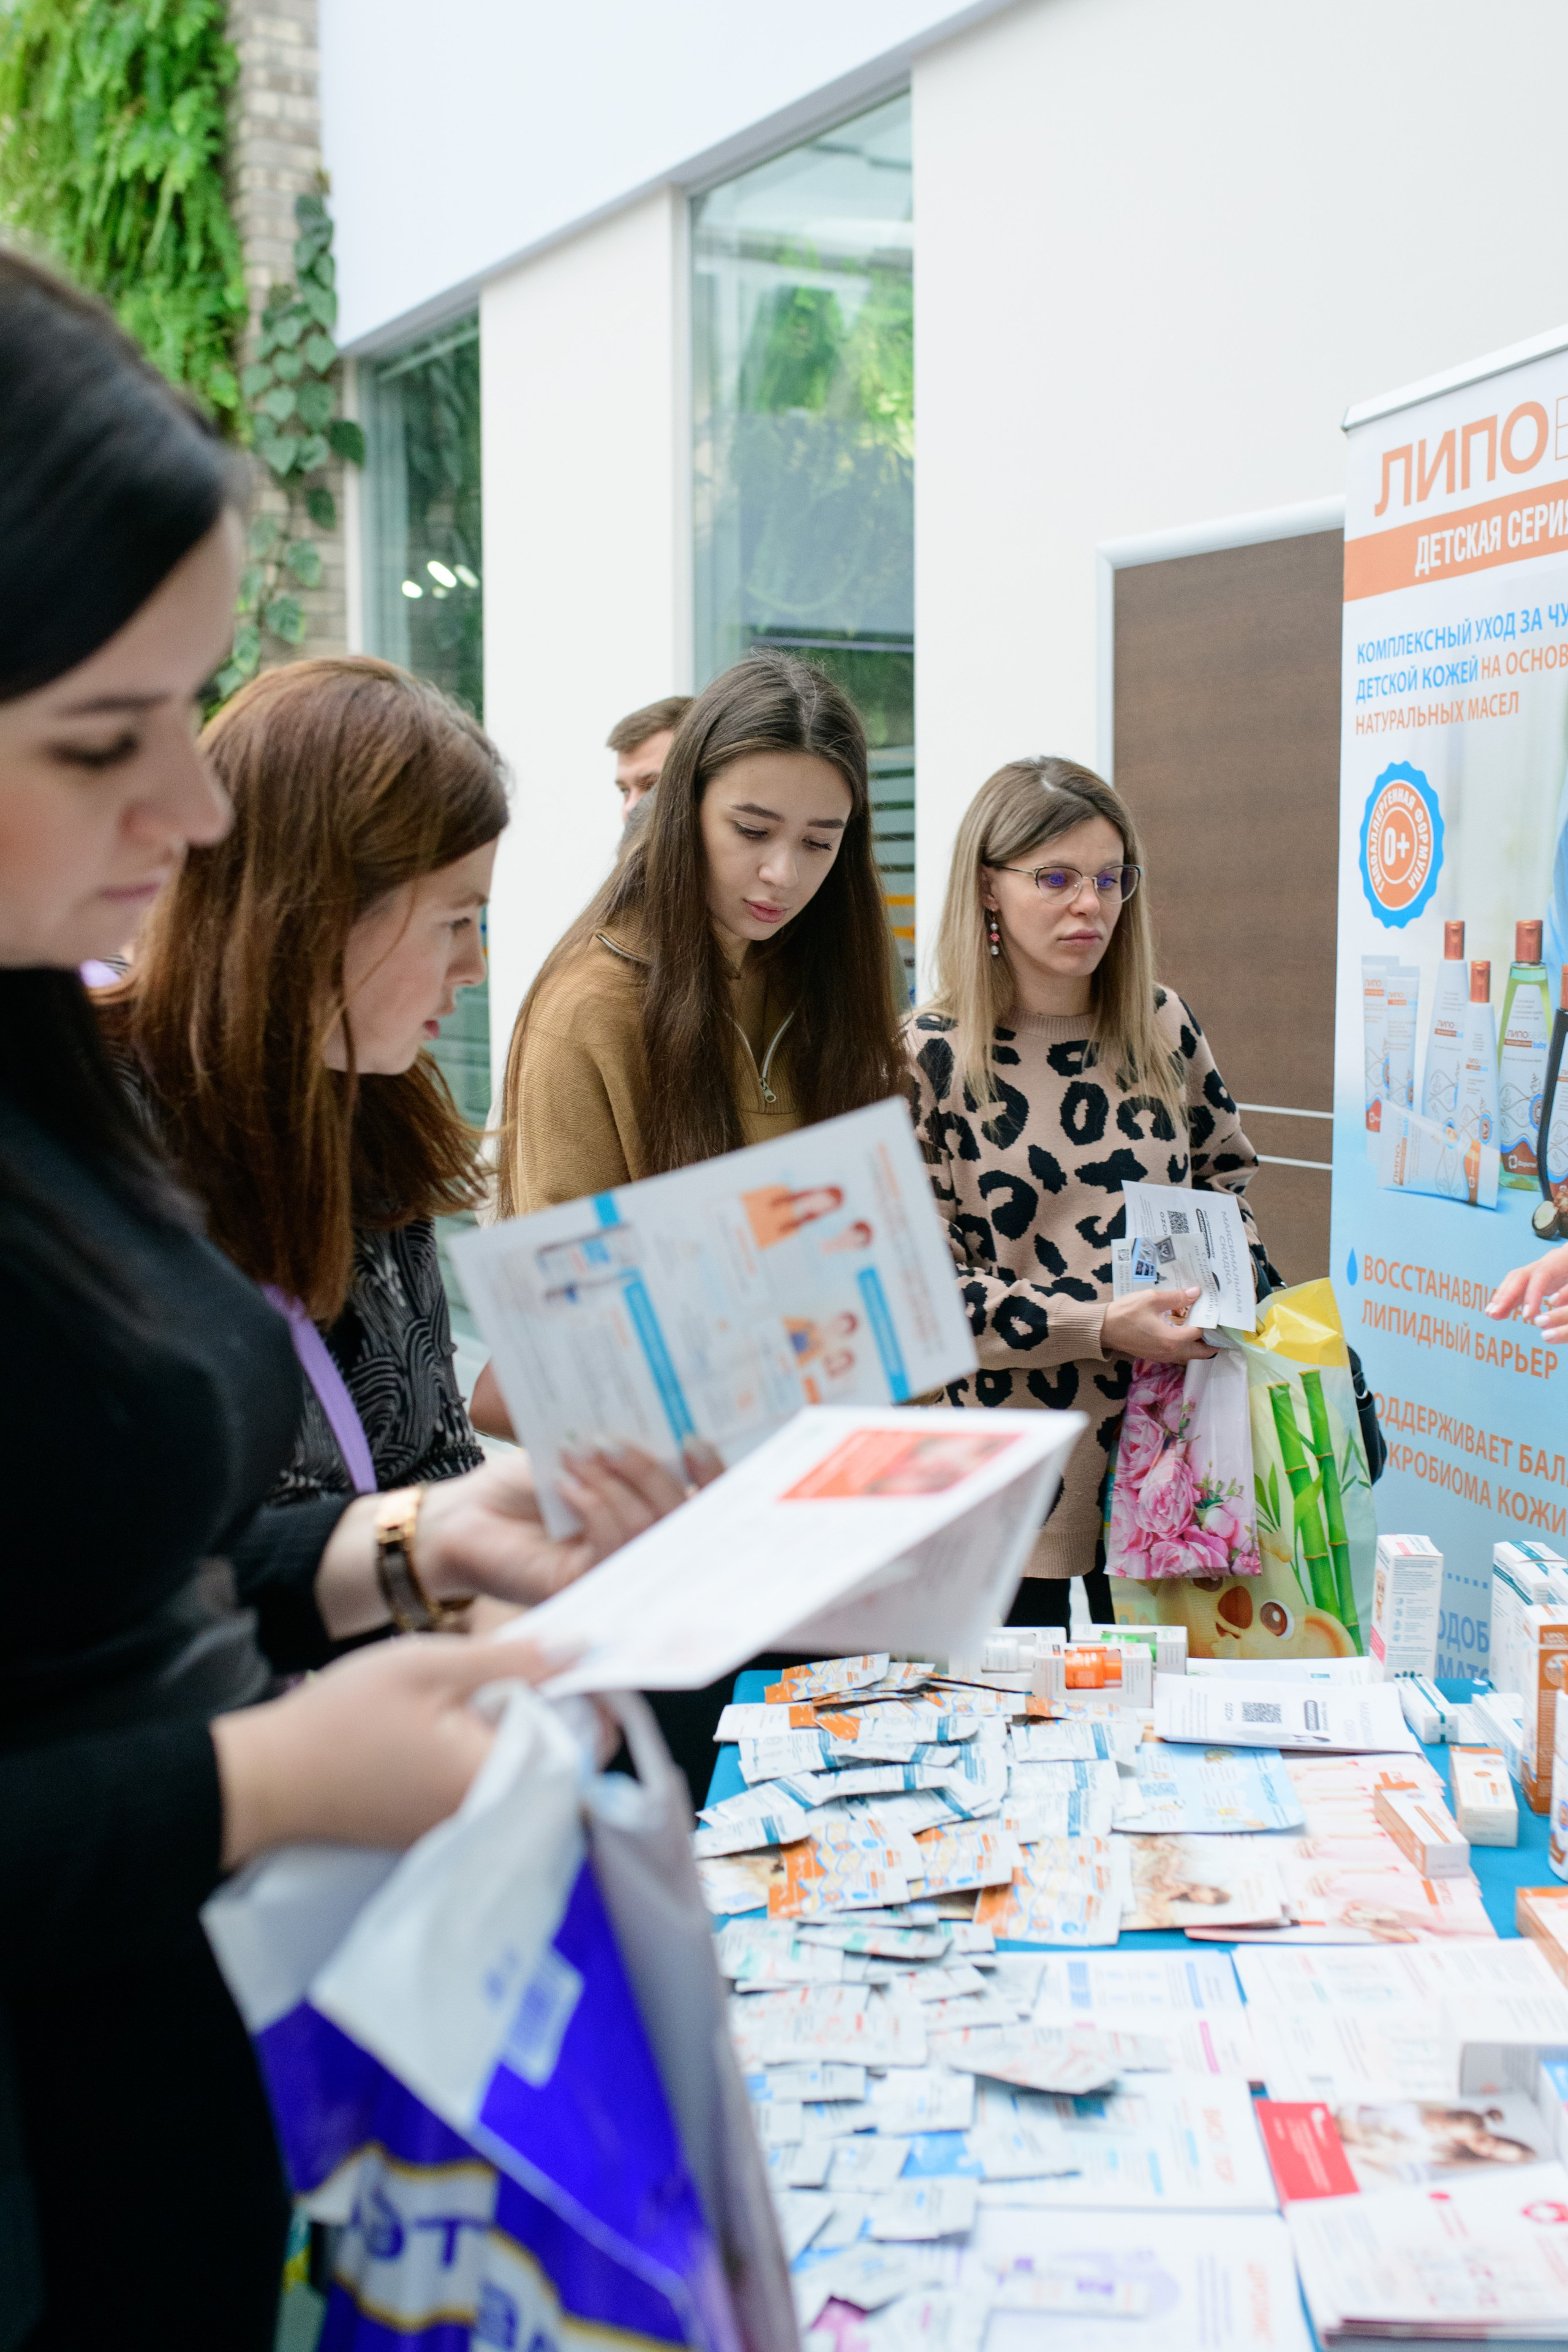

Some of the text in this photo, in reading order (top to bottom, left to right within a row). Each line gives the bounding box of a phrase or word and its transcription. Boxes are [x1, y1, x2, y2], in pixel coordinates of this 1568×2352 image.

[1415, 515, 1501, 577] ДЕТСКАЯ
[1357, 618, 1471, 665] КОМПЛЕКСНЫЙ
[1476, 612, 1515, 642] УХОД
[1520, 608, 1542, 633] ЗА
[1355, 665, 1417, 705] ДЕТСКОЙ
[1422, 654, 1478, 691] КОЖЕЙ
[1482, 654, 1501, 680] НА
[1355, 691, 1519, 736] НАТУРАЛЬНЫХ МАСЕЛ
[1384, 827, 1410, 866] 0+
[1408, 807, 1429, 891] ФОРМУЛА
[1219, 1235, 1232, 1285] СКИДКА
[1221, 1211, 1242, 1313] МАКСИМАЛЬНАЯ
[1362, 1300, 1558, 1379] ЛИПИДНЫЙ БАРЬЕР
[1374, 1392, 1568, 1488] ОДДЕРЖИВАЕТ БАЛ
[1384, 1441, 1567, 1537] КРОБИОМА КОЖИ
